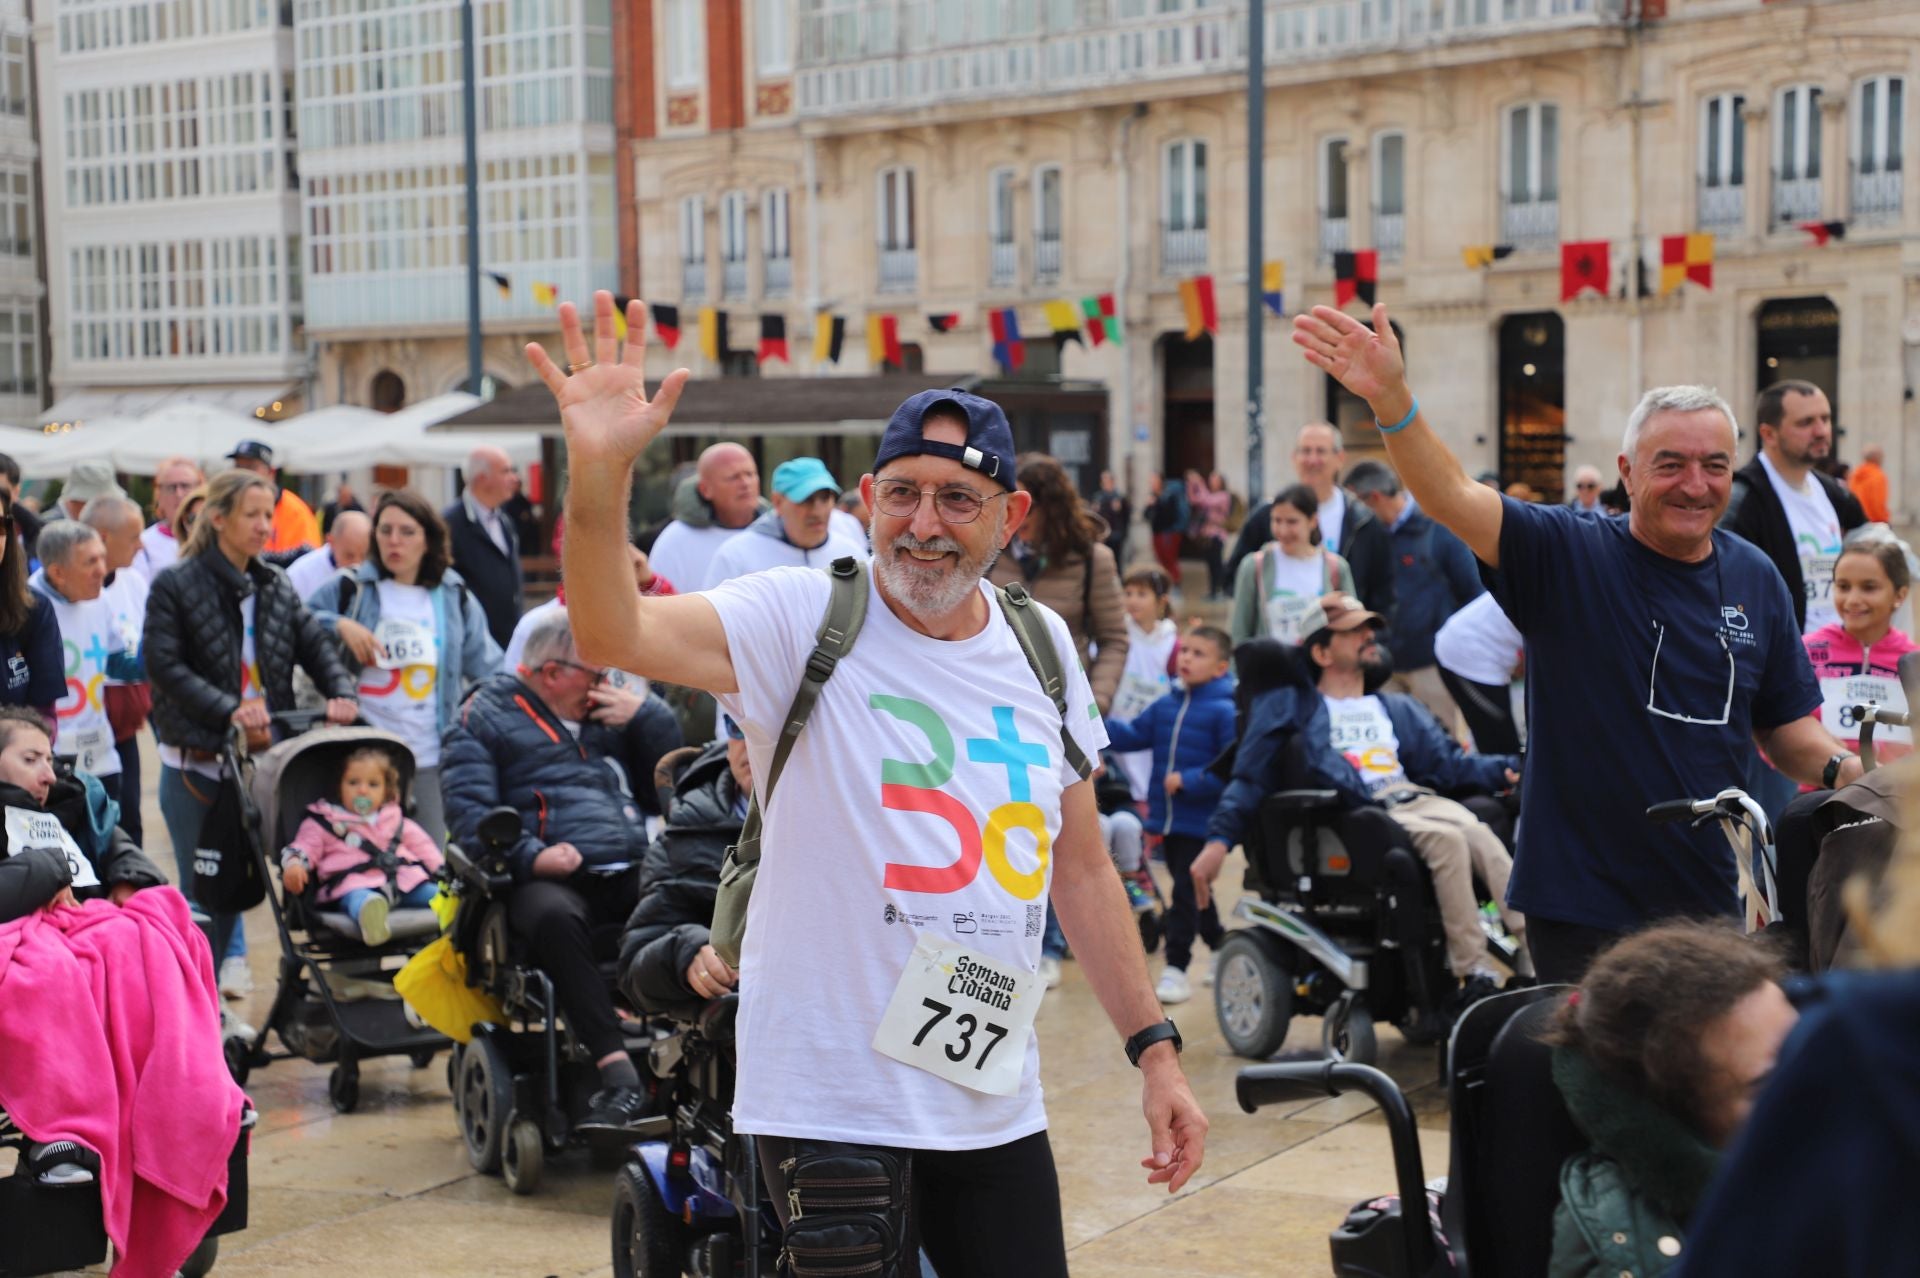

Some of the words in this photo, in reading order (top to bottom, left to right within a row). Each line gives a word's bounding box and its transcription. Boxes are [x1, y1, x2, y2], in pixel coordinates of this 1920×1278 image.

[947, 973, 1012, 1012] Cidiana
[955, 955, 1015, 993] Semana
[912, 996, 1009, 1070] 737
